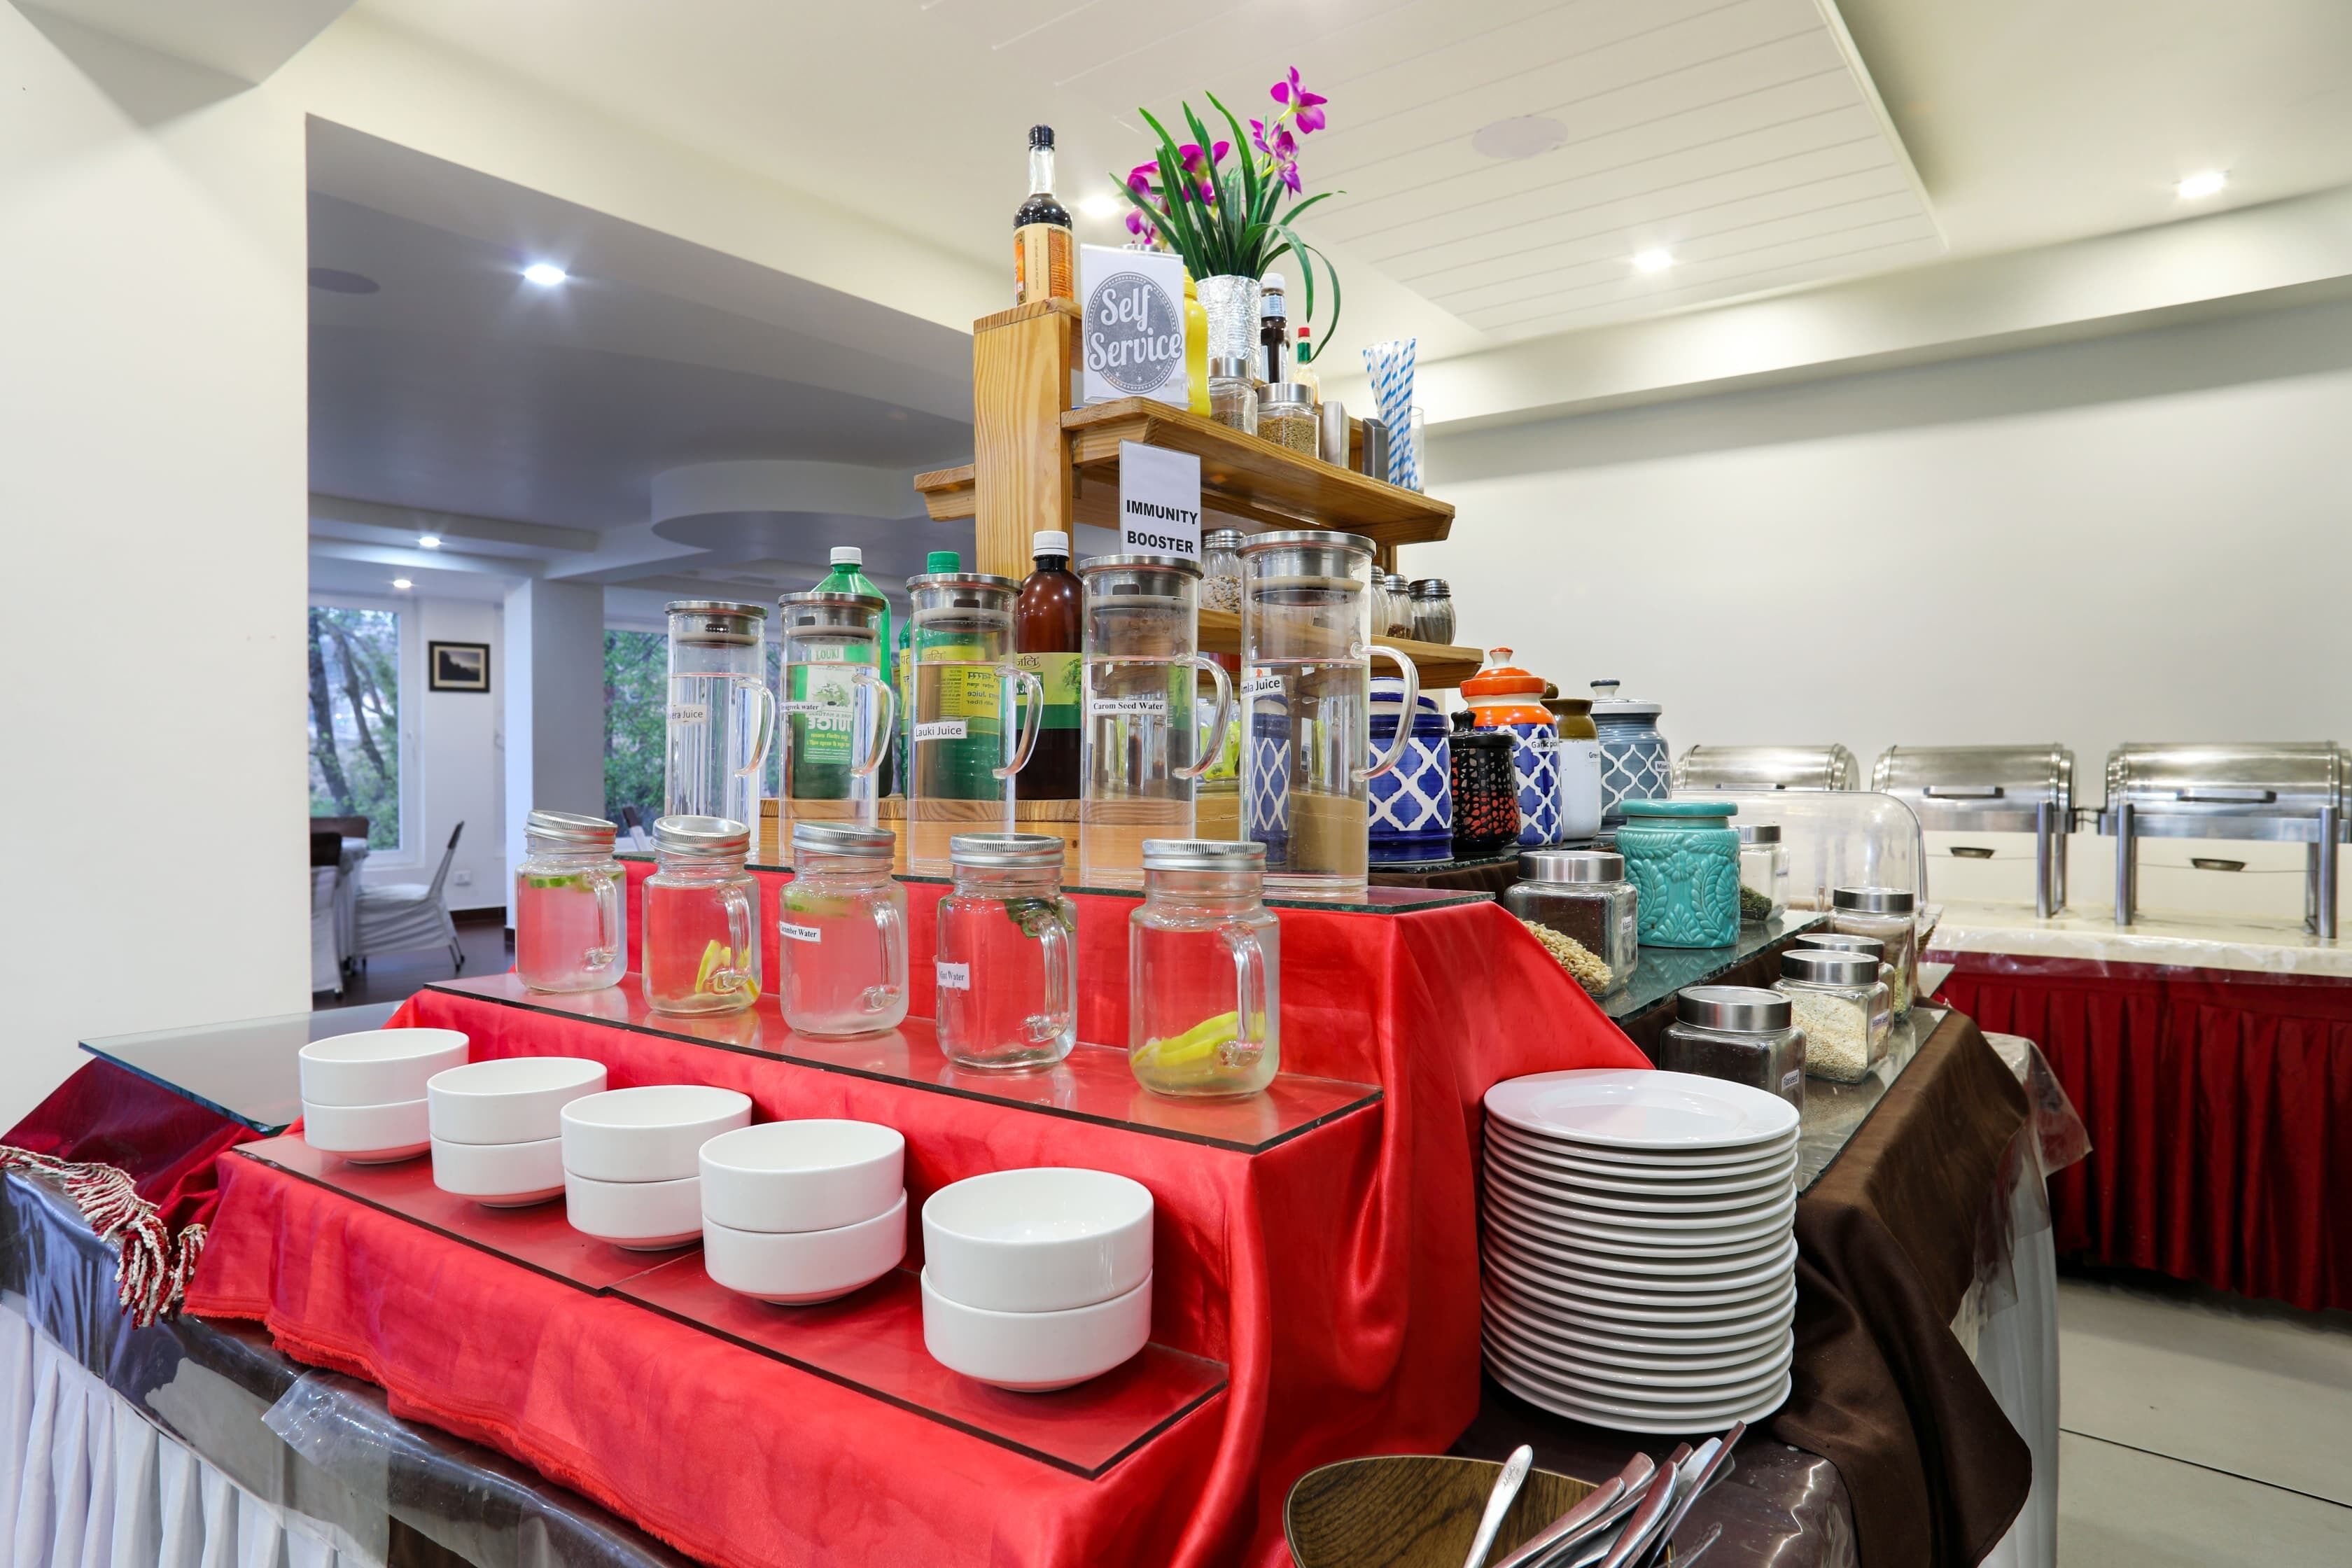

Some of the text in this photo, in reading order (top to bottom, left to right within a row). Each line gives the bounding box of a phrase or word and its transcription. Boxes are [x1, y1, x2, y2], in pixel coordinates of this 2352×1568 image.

[1100, 284, 1154, 332] Self
[1088, 327, 1182, 371] Service
[1126, 499, 1198, 525] IMMUNITY
[1127, 530, 1194, 554] BOOSTER
[1255, 678, 1280, 691] Juice
[682, 710, 704, 718] Juice
[916, 726, 962, 737] Lauki Juice
[798, 928, 818, 938] Water
[947, 970, 965, 981] Water
